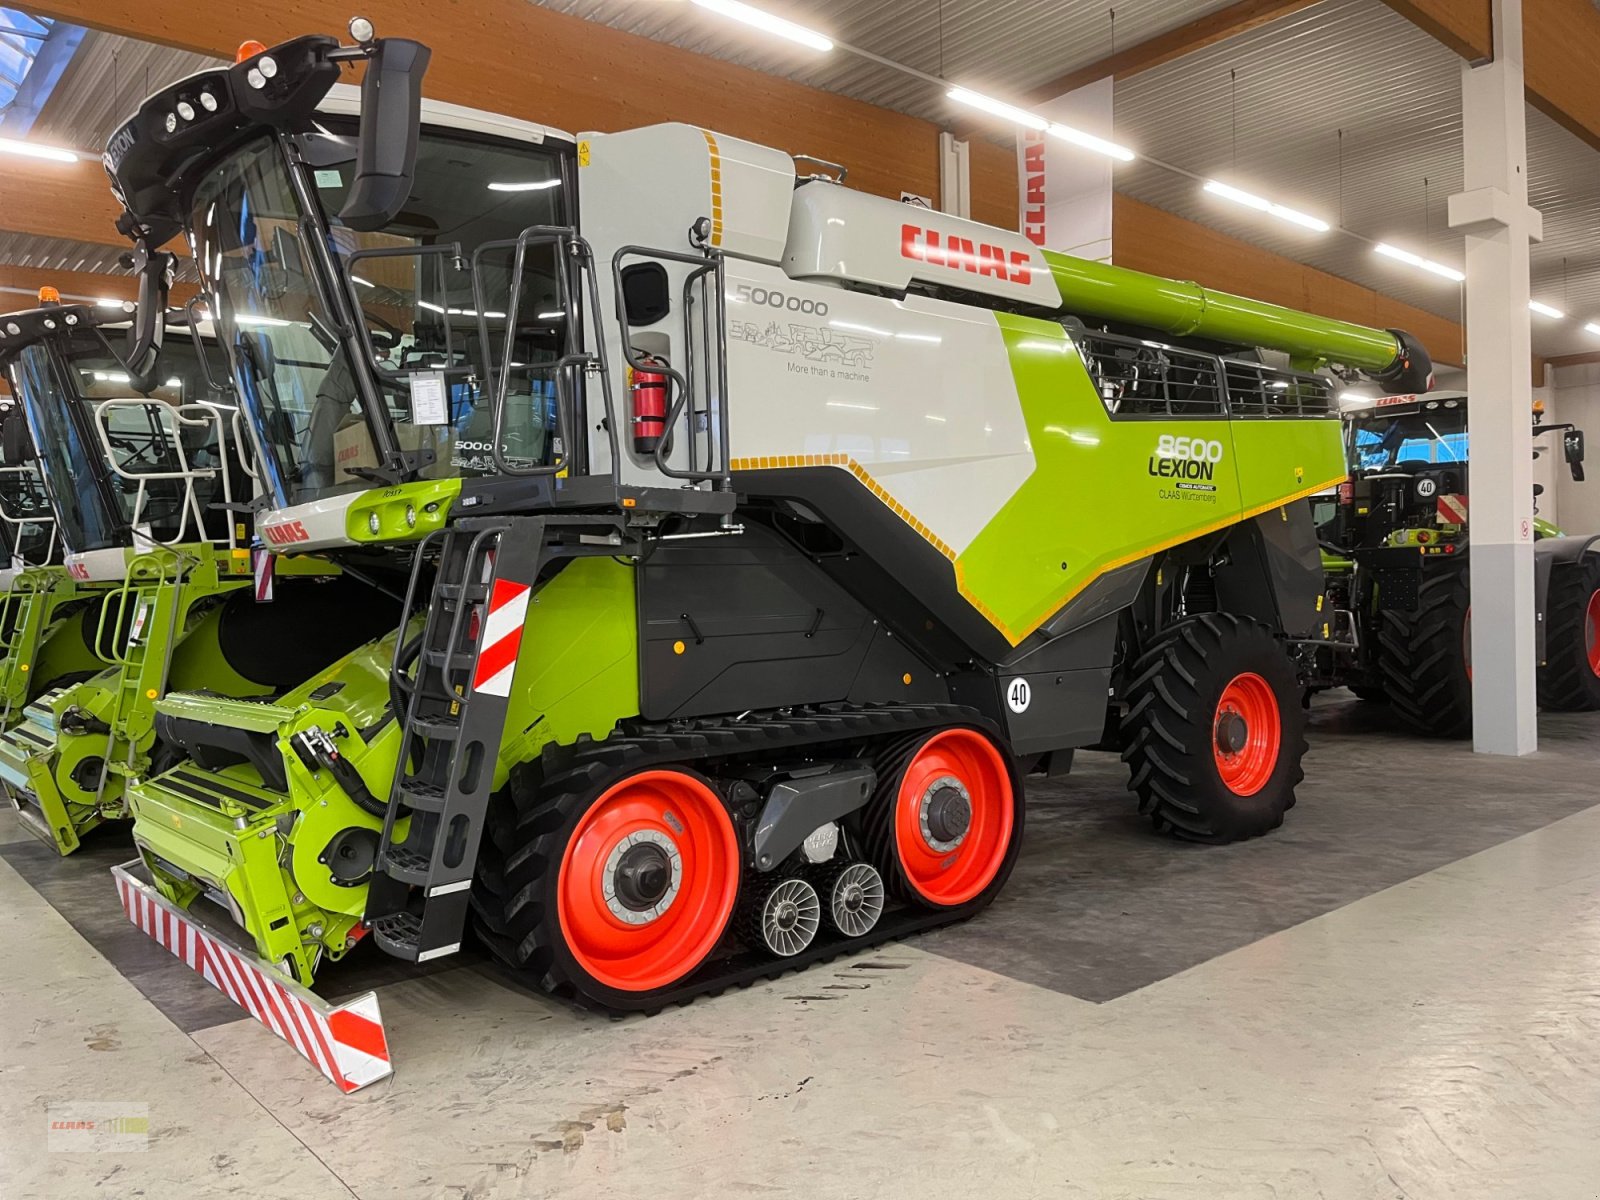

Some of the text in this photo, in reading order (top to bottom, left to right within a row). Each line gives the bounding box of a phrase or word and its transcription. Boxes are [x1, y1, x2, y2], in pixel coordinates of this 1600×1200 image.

[900, 223, 1032, 286] CLAAS
[736, 284, 828, 317] 500 000
[787, 361, 870, 383] More than a machine
[1376, 394, 1417, 407] CLAAS
[454, 440, 508, 453] 500 00
[1157, 434, 1223, 464] 8600
[1148, 456, 1214, 481] LEXION
[1158, 488, 1181, 500] CLAAS
[1420, 481, 1432, 494] 40
[1011, 683, 1027, 707] 40
